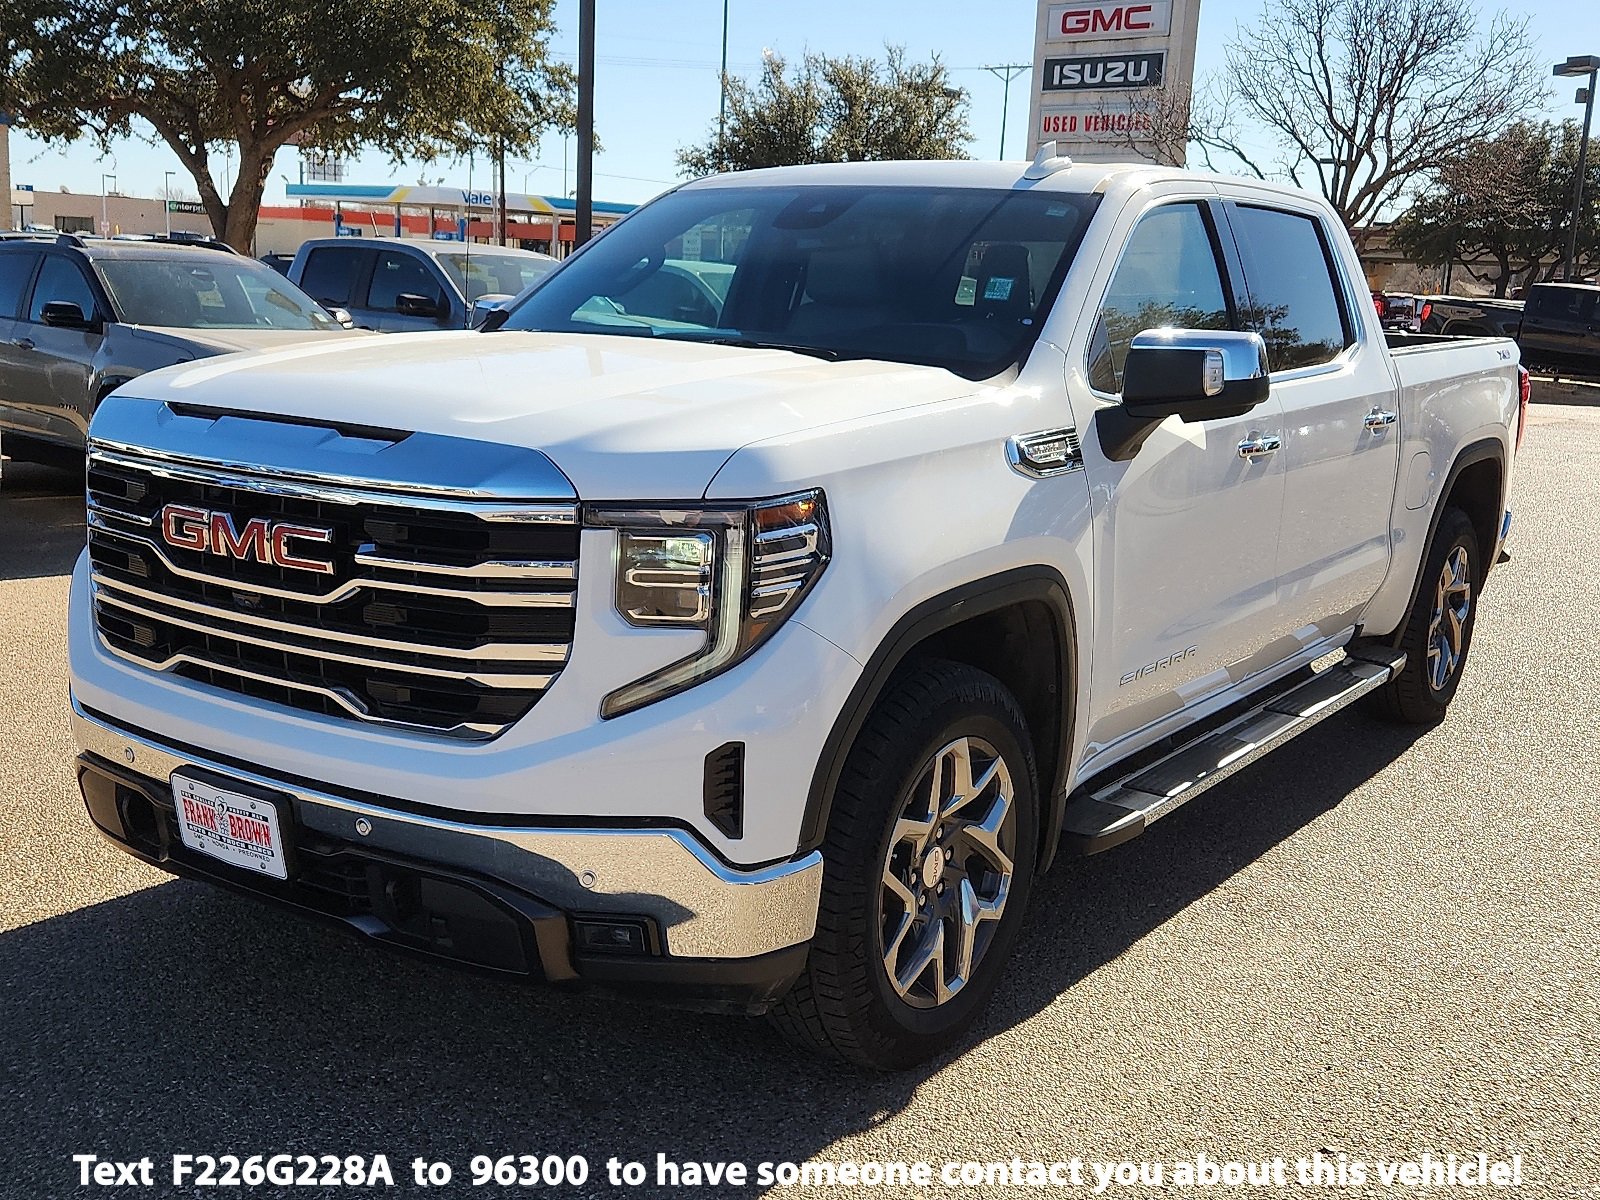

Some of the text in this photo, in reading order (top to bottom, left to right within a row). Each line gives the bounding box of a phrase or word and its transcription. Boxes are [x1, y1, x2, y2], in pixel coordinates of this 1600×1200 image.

[1061, 5, 1152, 34] GMC
[1052, 60, 1148, 85] ISUZU
[1043, 115, 1077, 133] USED
[169, 202, 207, 213] enterpri
[462, 191, 501, 205] Vale
[162, 503, 335, 575] GMC
[1119, 644, 1198, 687] SIERRA
[182, 798, 272, 848] FRANK BROWN
[208, 830, 221, 840] AND
